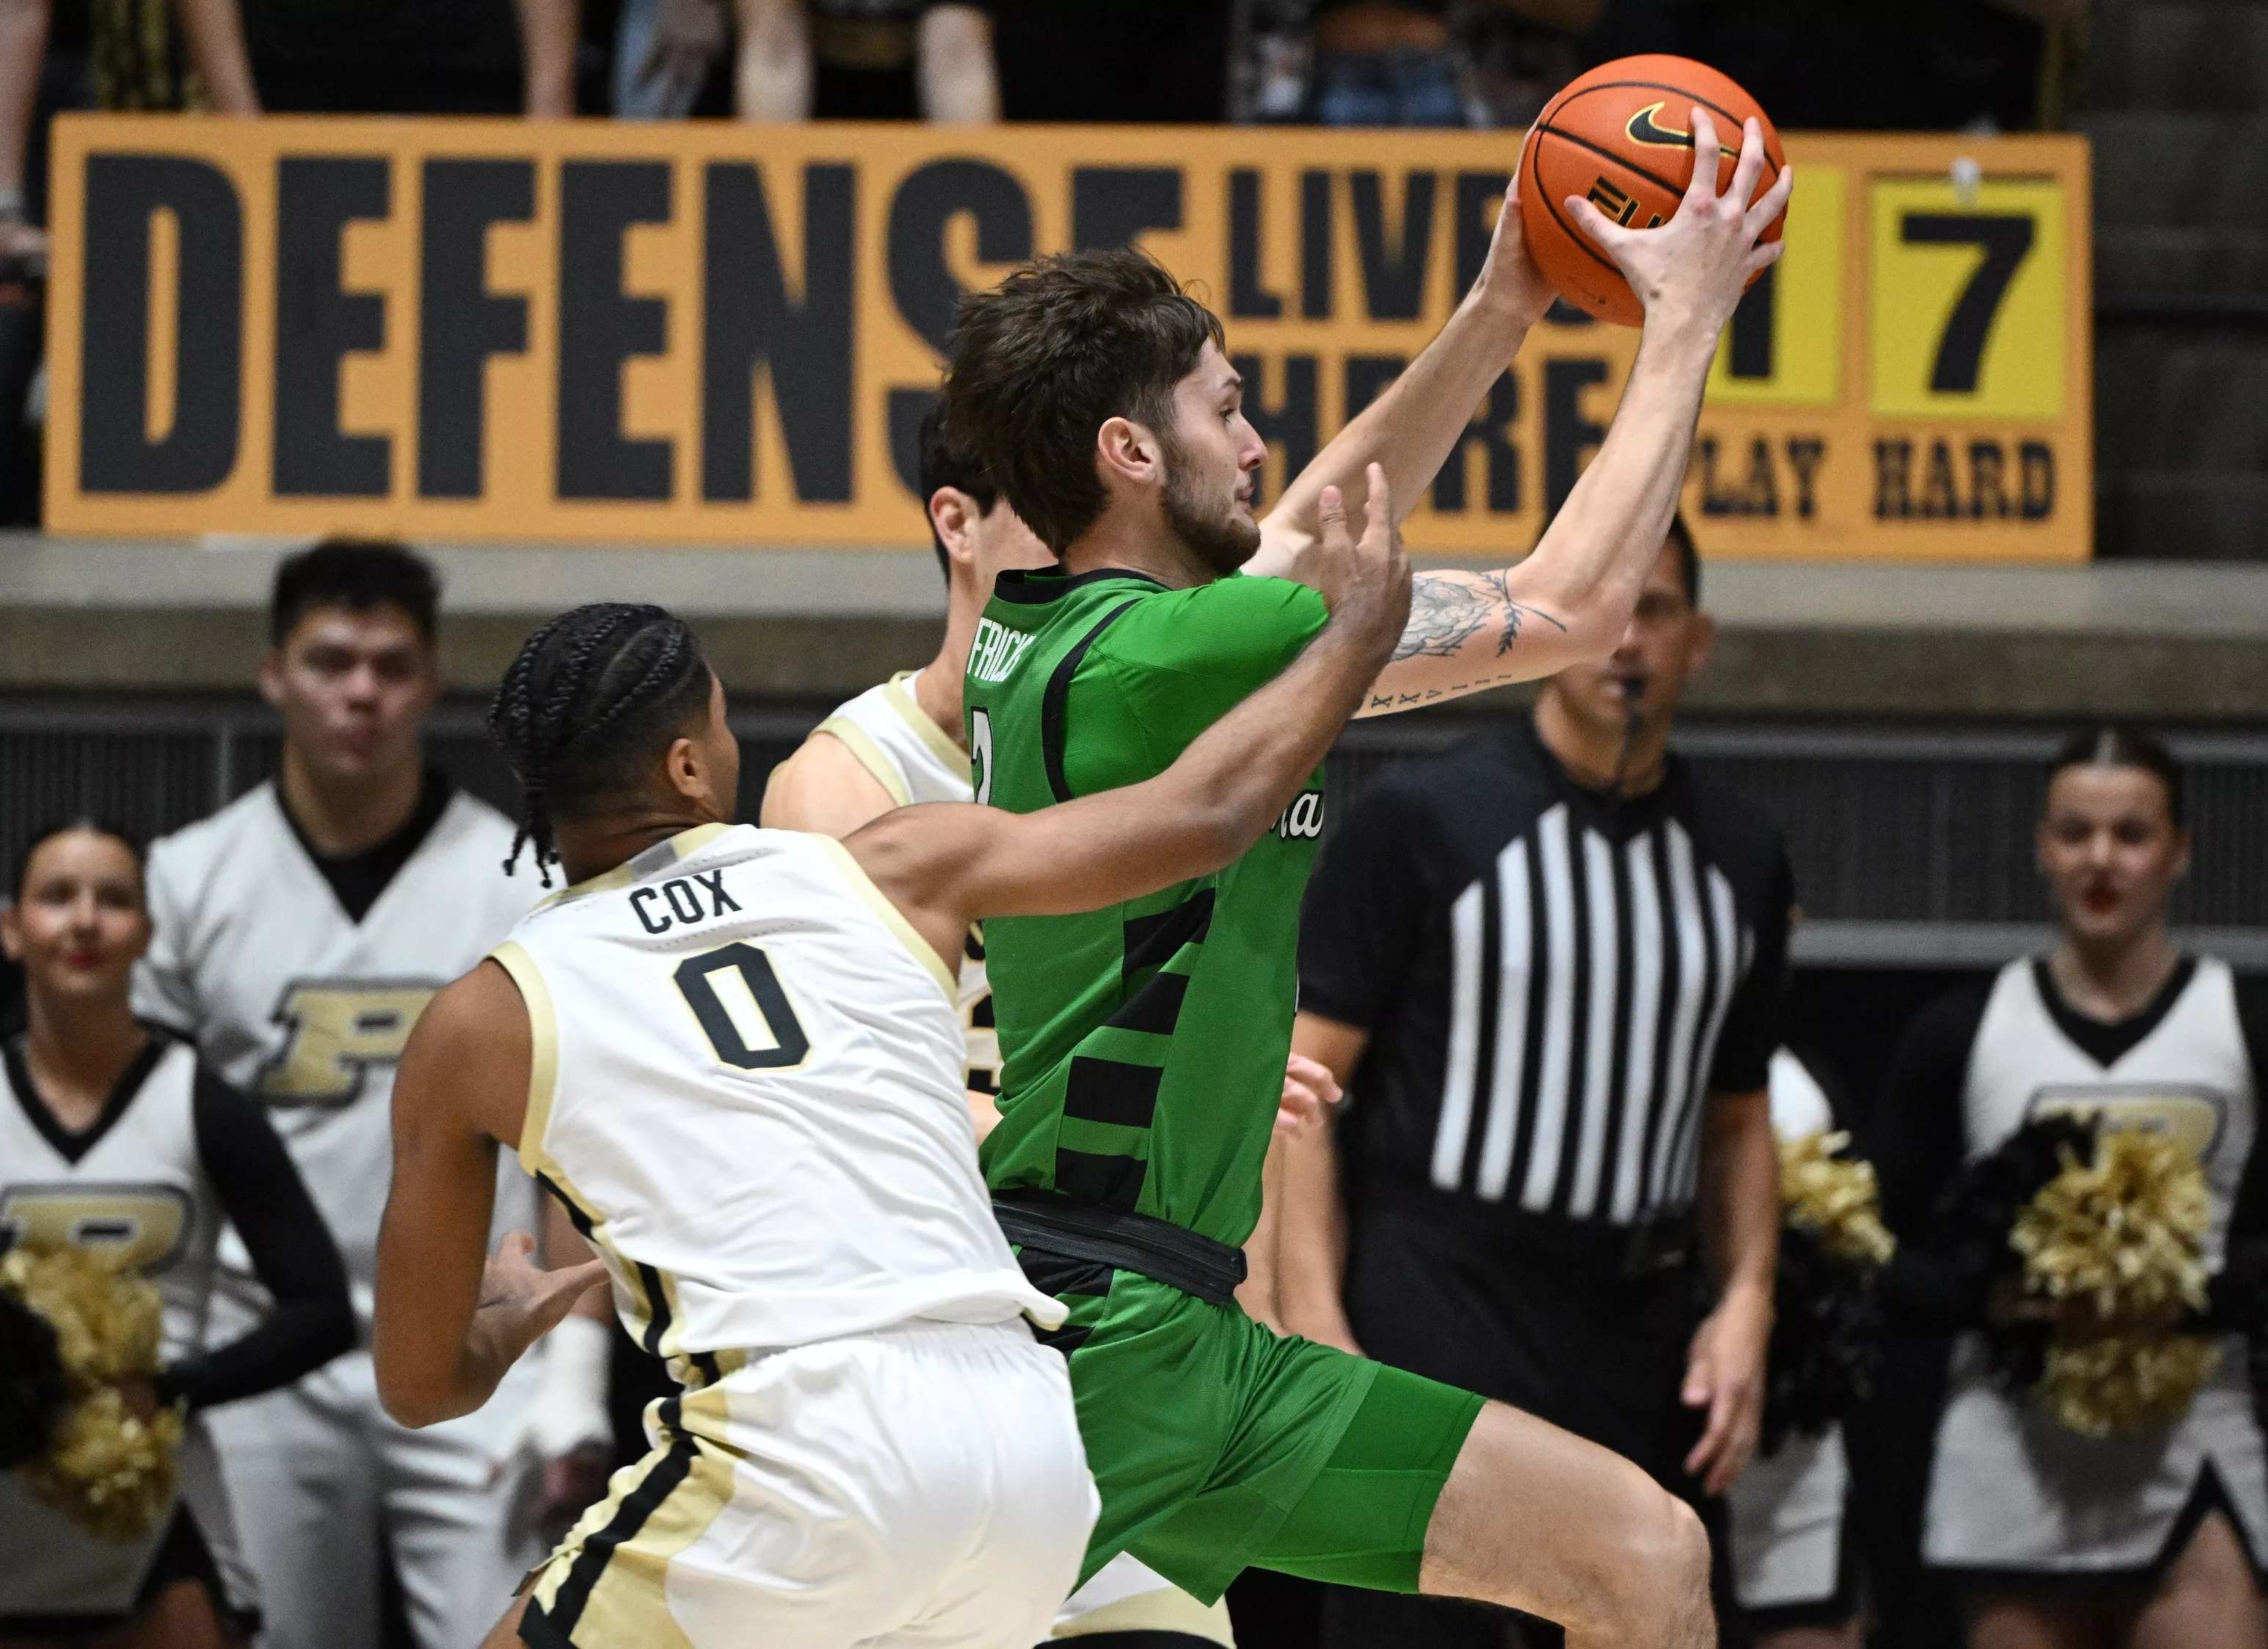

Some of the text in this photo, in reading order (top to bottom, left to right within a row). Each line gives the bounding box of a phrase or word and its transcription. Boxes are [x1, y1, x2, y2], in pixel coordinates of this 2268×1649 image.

[79, 153, 1186, 503] DEFENS
[1689, 437, 2054, 522] LAY HARD
[629, 869, 743, 934] COX
[671, 939, 812, 1073] 0
